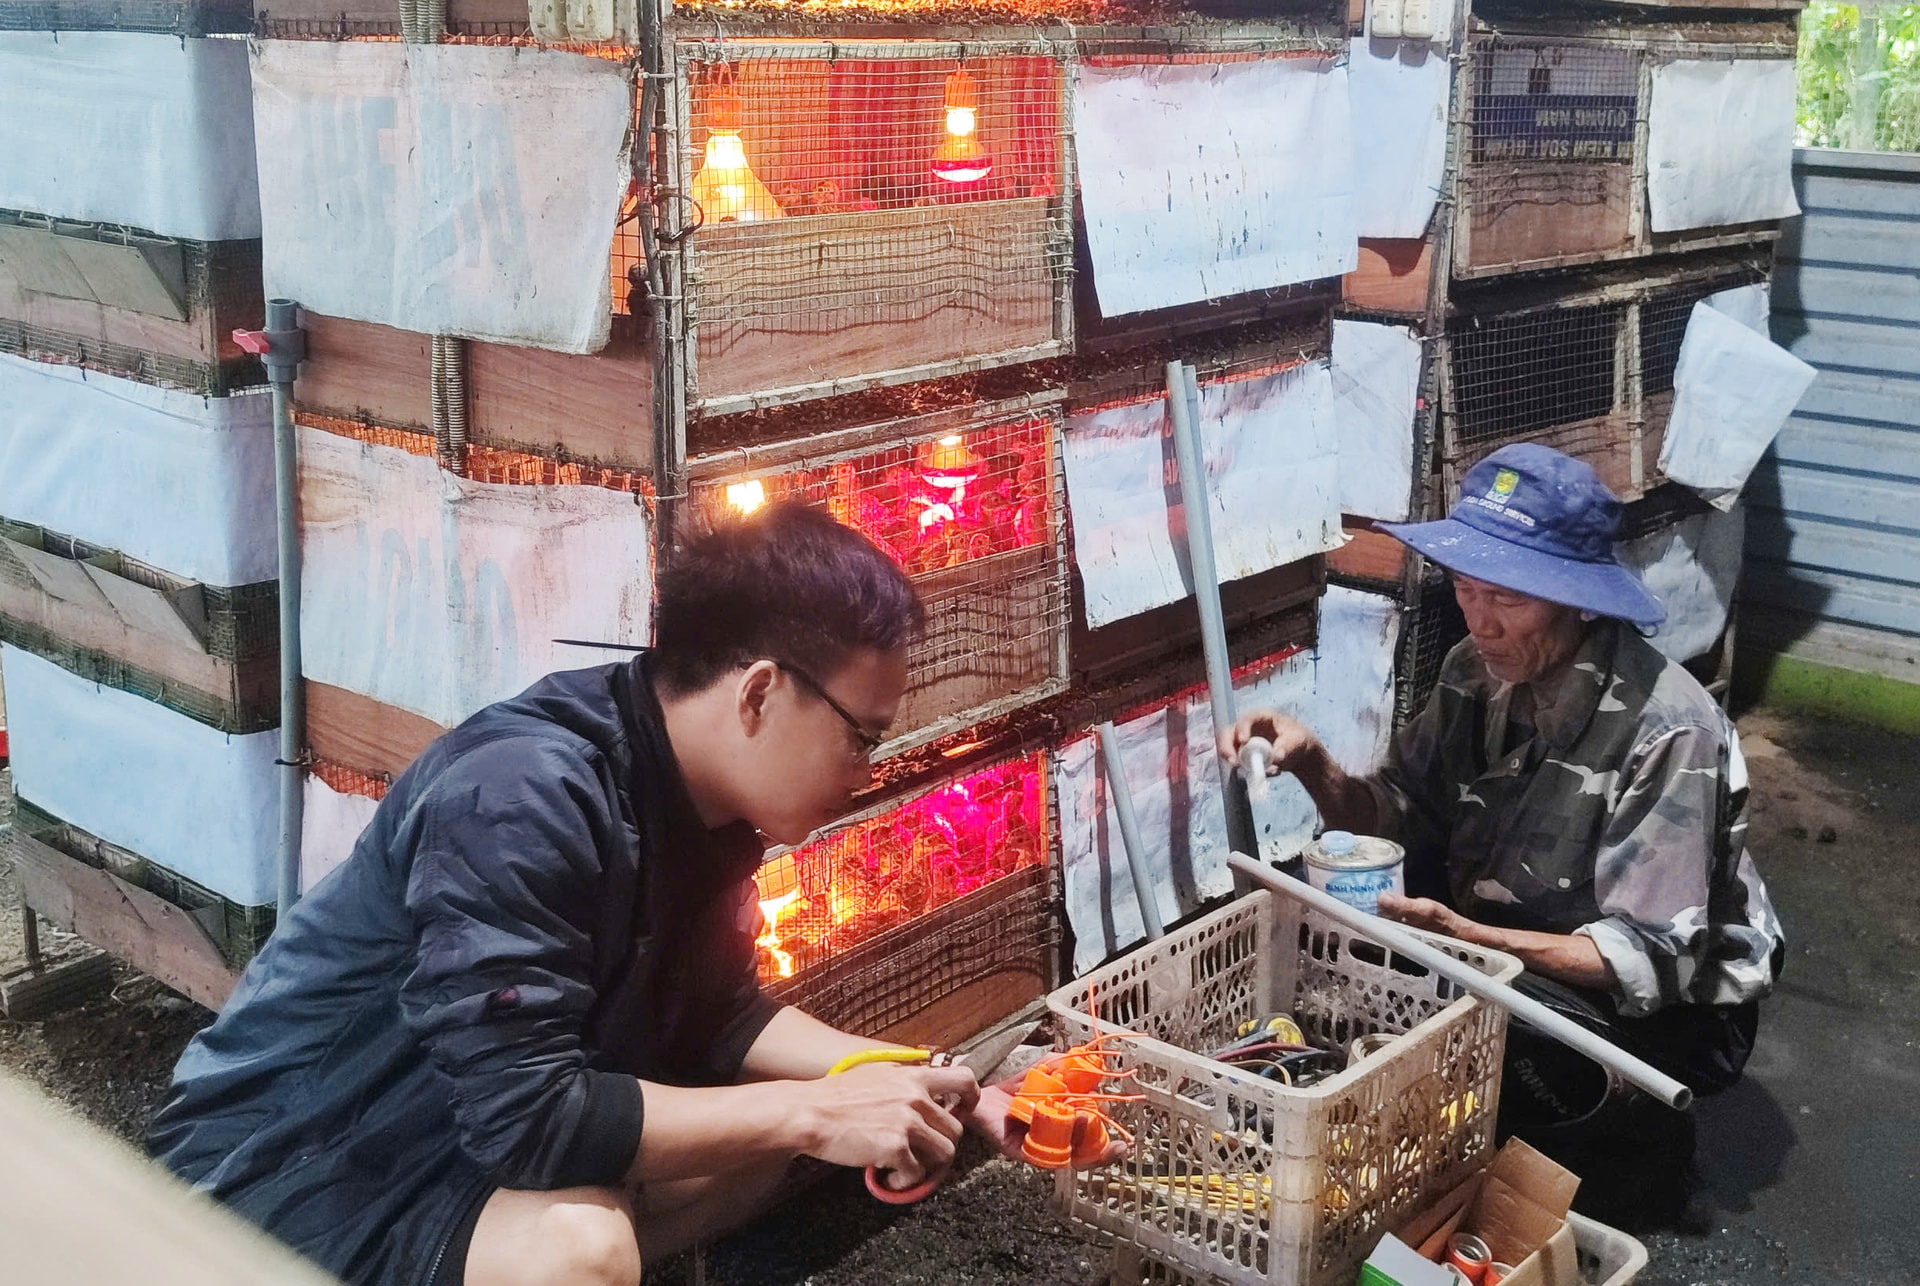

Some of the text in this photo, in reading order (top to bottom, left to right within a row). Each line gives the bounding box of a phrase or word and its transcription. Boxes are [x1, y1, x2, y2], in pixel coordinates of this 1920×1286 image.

[1536, 109, 1571, 127] NAM
[1479, 499, 1504, 512] GROUND
[1504, 508, 1535, 526] SERVICES
